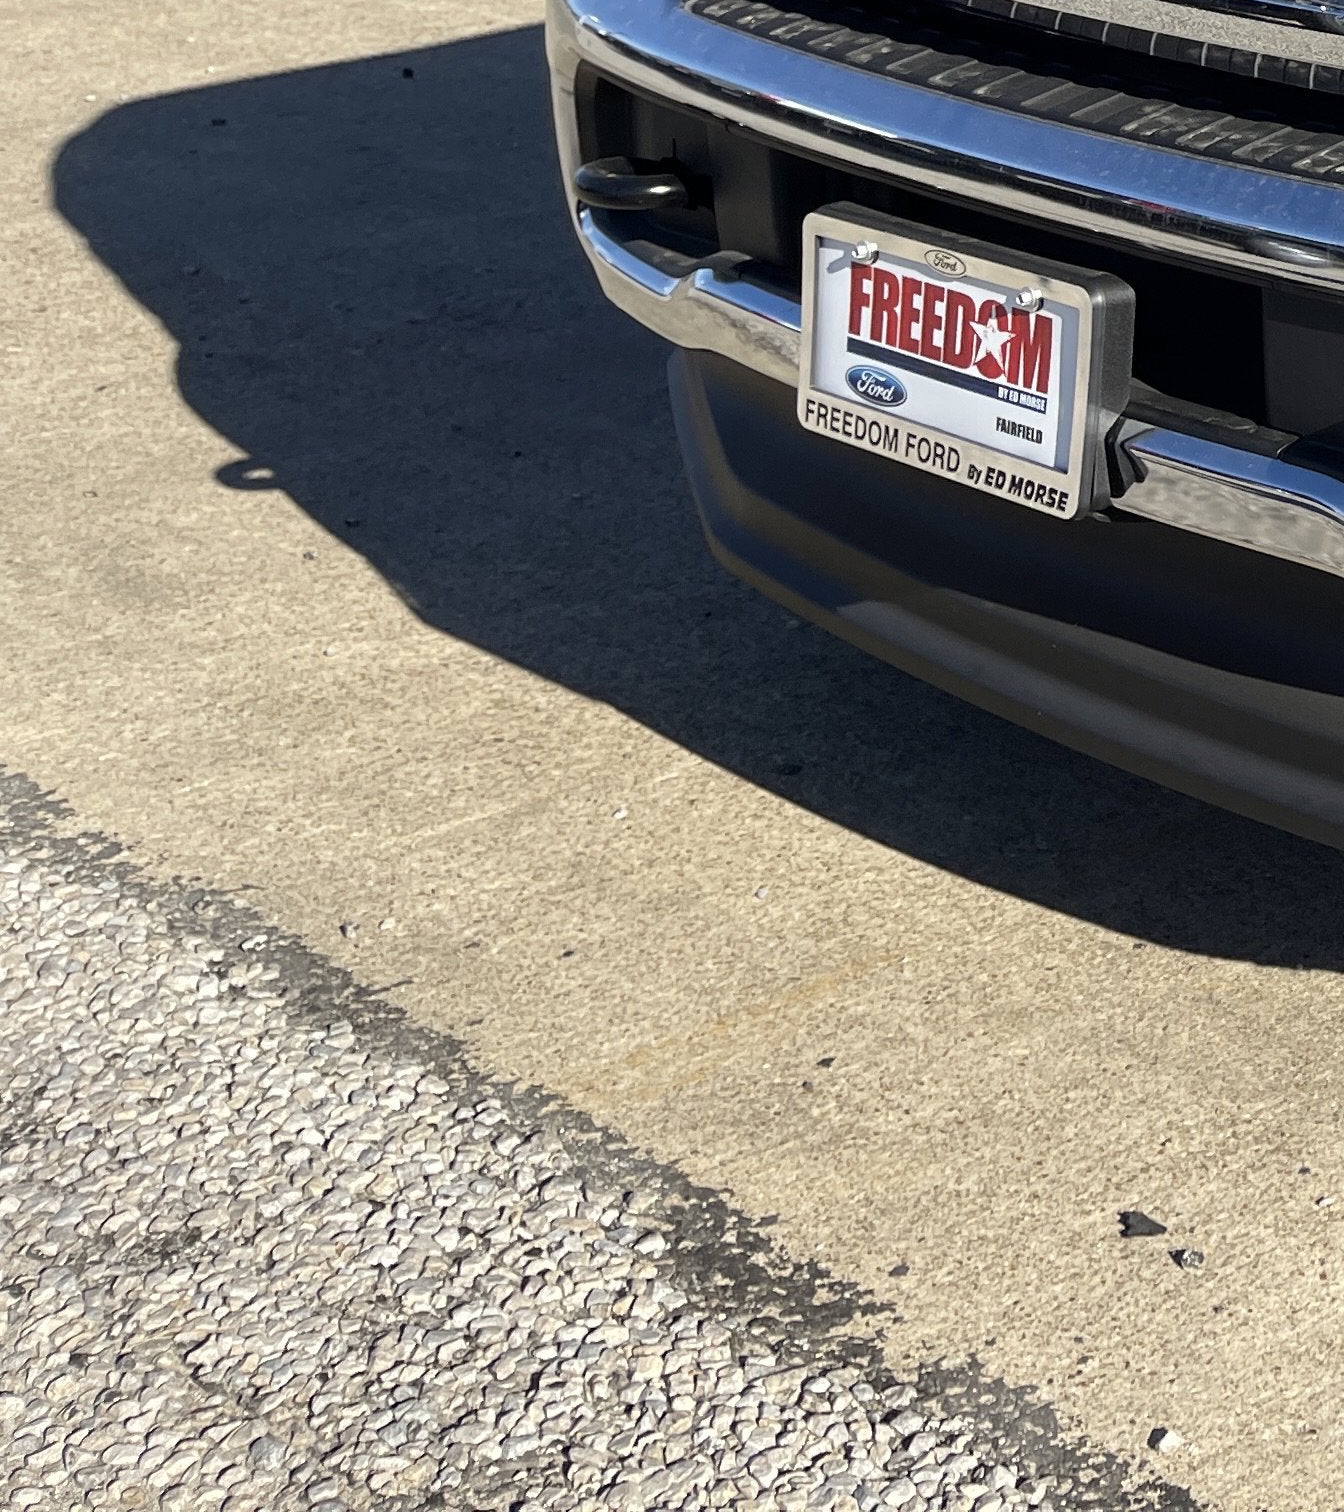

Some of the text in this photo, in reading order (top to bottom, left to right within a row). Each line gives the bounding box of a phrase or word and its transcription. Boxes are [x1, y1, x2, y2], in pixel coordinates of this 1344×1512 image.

[933, 252, 958, 272] Ford
[847, 261, 1053, 395] FREEDOM
[855, 367, 896, 405] Ford
[996, 416, 1043, 445] FAIRFIELD
[805, 398, 899, 454] FREEDOM
[905, 432, 961, 474] FORD
[984, 466, 1006, 491] ED
[1007, 474, 1070, 513] MORSE
